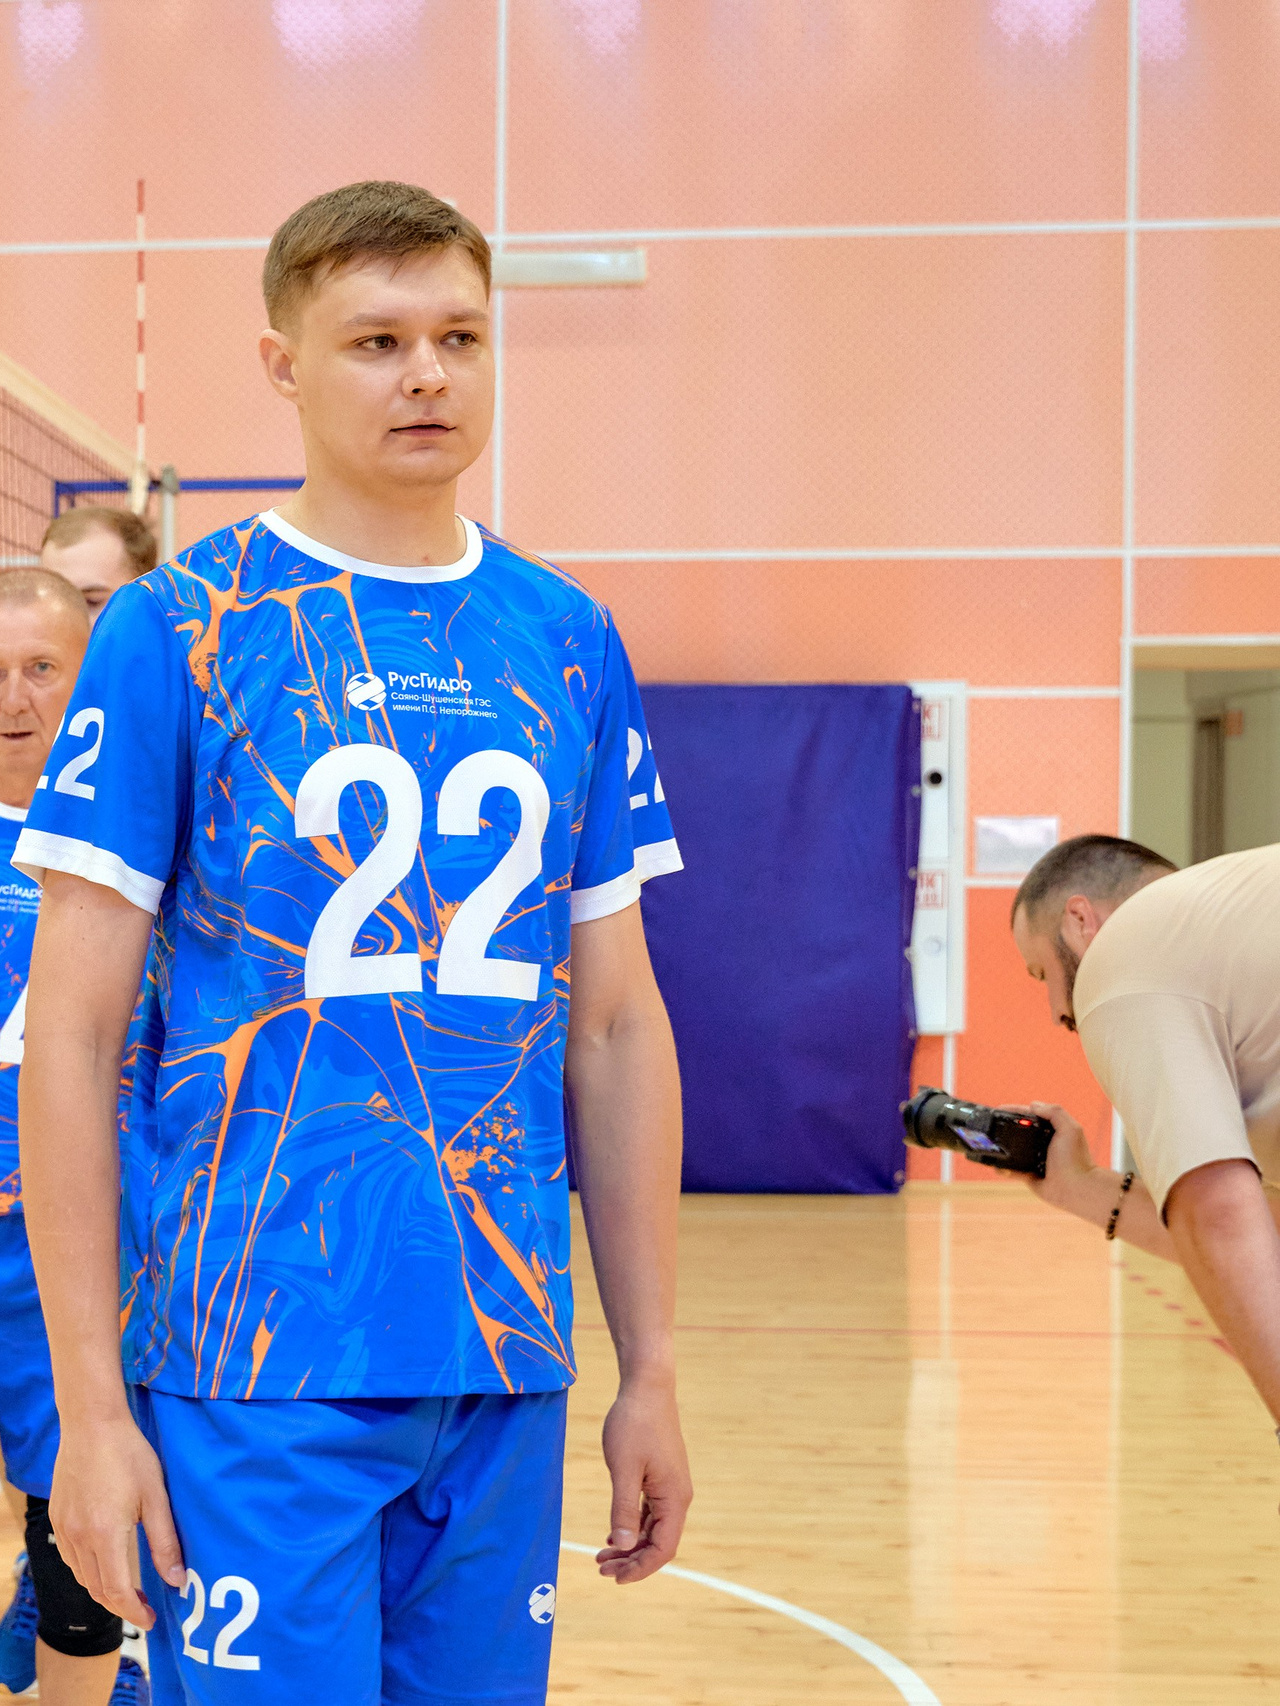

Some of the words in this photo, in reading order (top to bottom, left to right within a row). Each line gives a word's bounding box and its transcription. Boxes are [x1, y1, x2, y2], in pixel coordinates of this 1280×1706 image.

[388, 672, 472, 693] РусГидро
[391, 691, 474, 704] Саяно-Шушенская
[475, 697, 491, 707] ГЭС
[392, 704, 421, 712] имени
[440, 706, 497, 718] Непорожнего
[294, 743, 551, 1002] 22
[179, 1567, 261, 1671] 22
